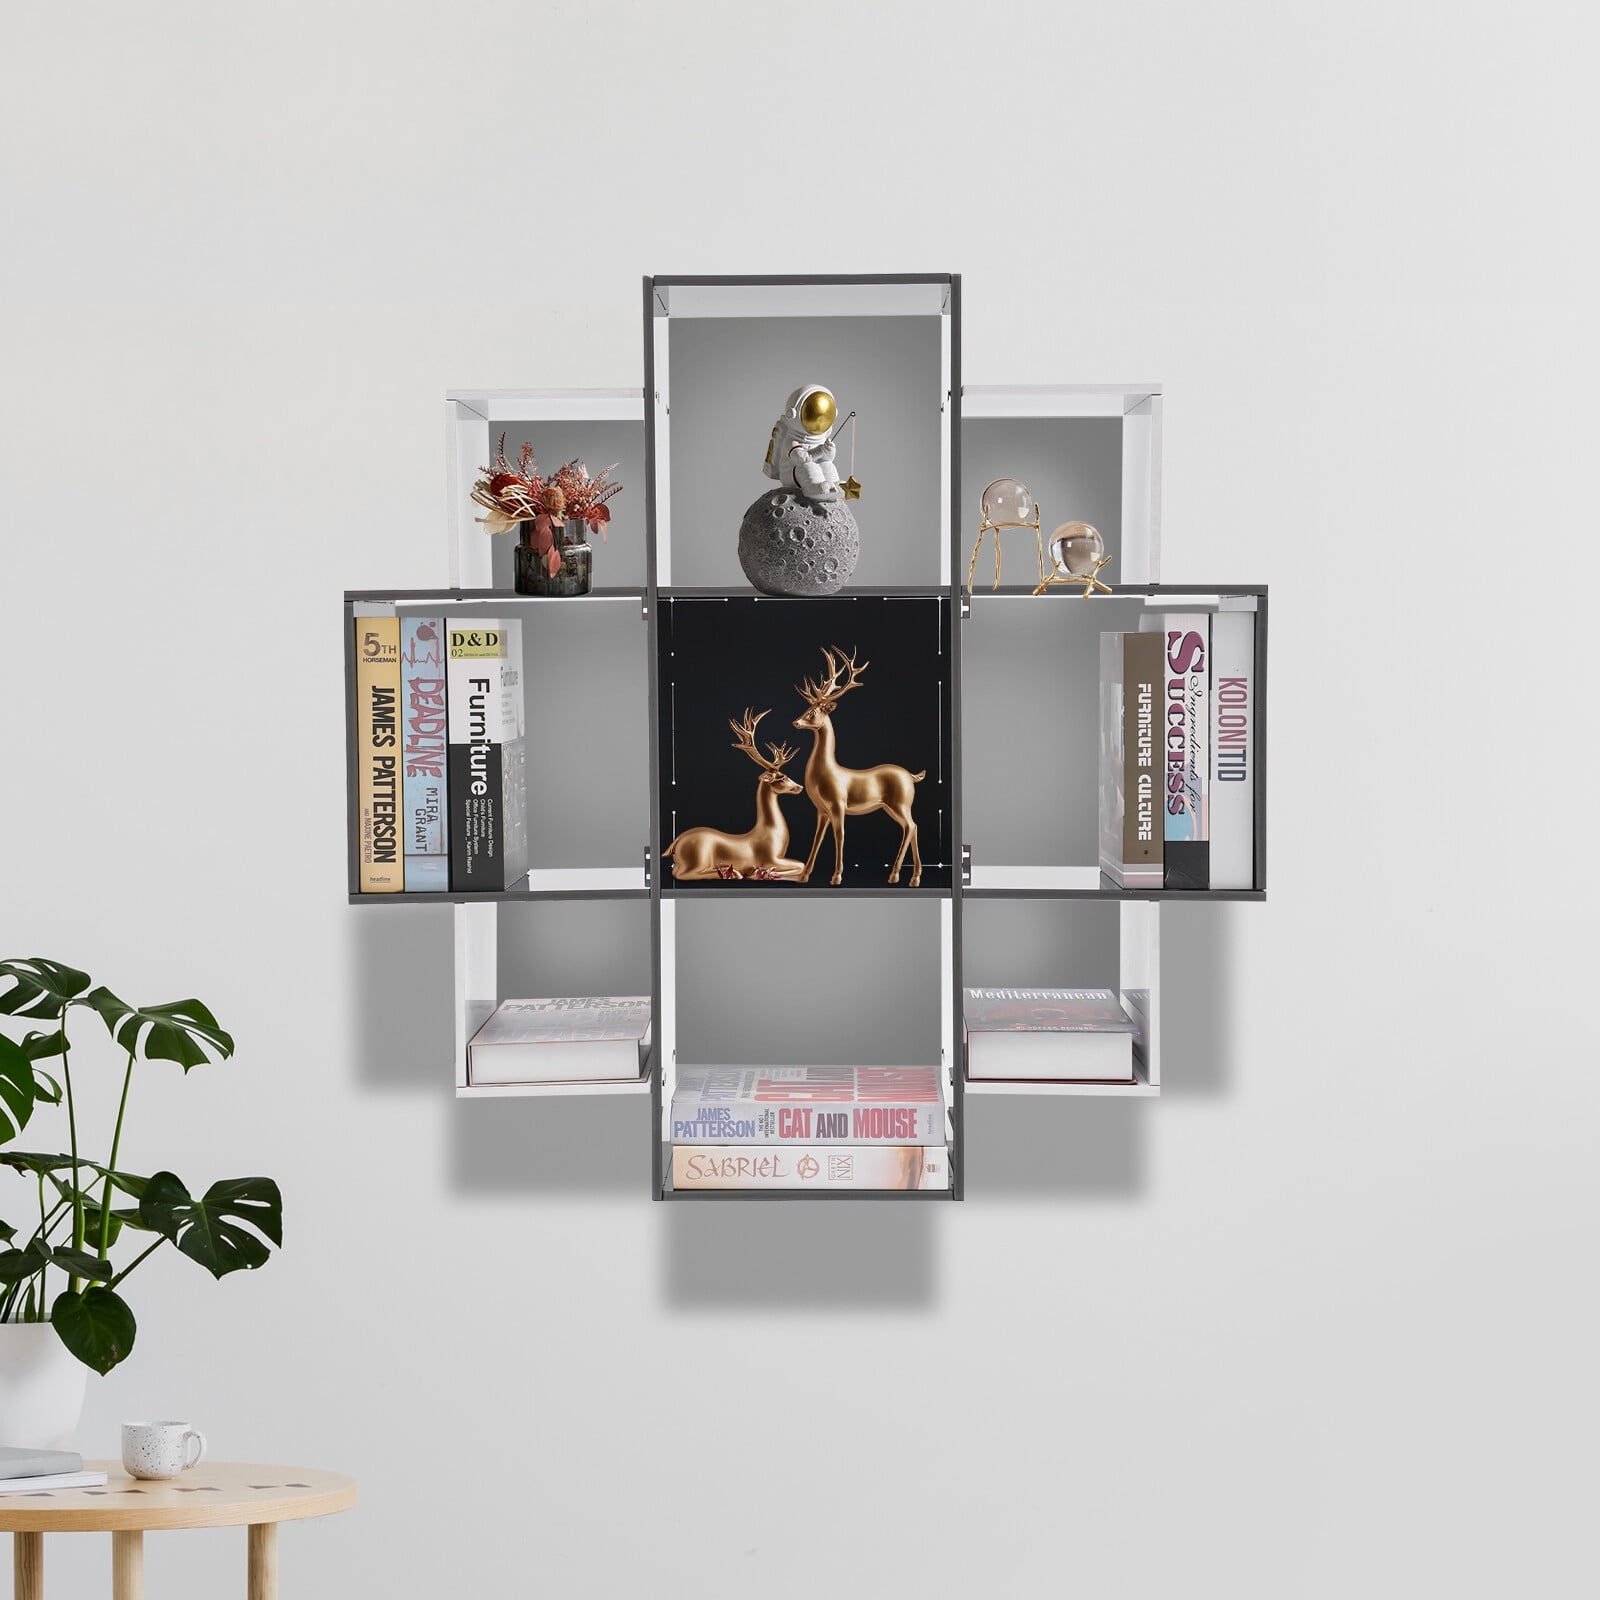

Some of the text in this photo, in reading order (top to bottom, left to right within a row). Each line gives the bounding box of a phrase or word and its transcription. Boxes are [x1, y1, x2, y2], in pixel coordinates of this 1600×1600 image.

[363, 632, 397, 657] 5TH
[452, 632, 498, 647] D & D
[404, 677, 446, 778] DEADLINE
[468, 678, 491, 797] Furniture
[1184, 675, 1203, 813] Ingredients for
[1218, 677, 1248, 782] KOLONITID
[371, 685, 397, 864] JAMES PATTERSON
[425, 787, 439, 823] MIRA
[1138, 774, 1152, 841] CULTURE
[415, 808, 427, 853] GRANT
[369, 876, 391, 884] headline
[969, 988, 1108, 1000] Mediterranean
[674, 1120, 756, 1138] PATTERSON
[696, 1108, 731, 1121] JAMES
[778, 1108, 918, 1139] CAT AND MOUSE
[837, 1157, 851, 1179] NIX
